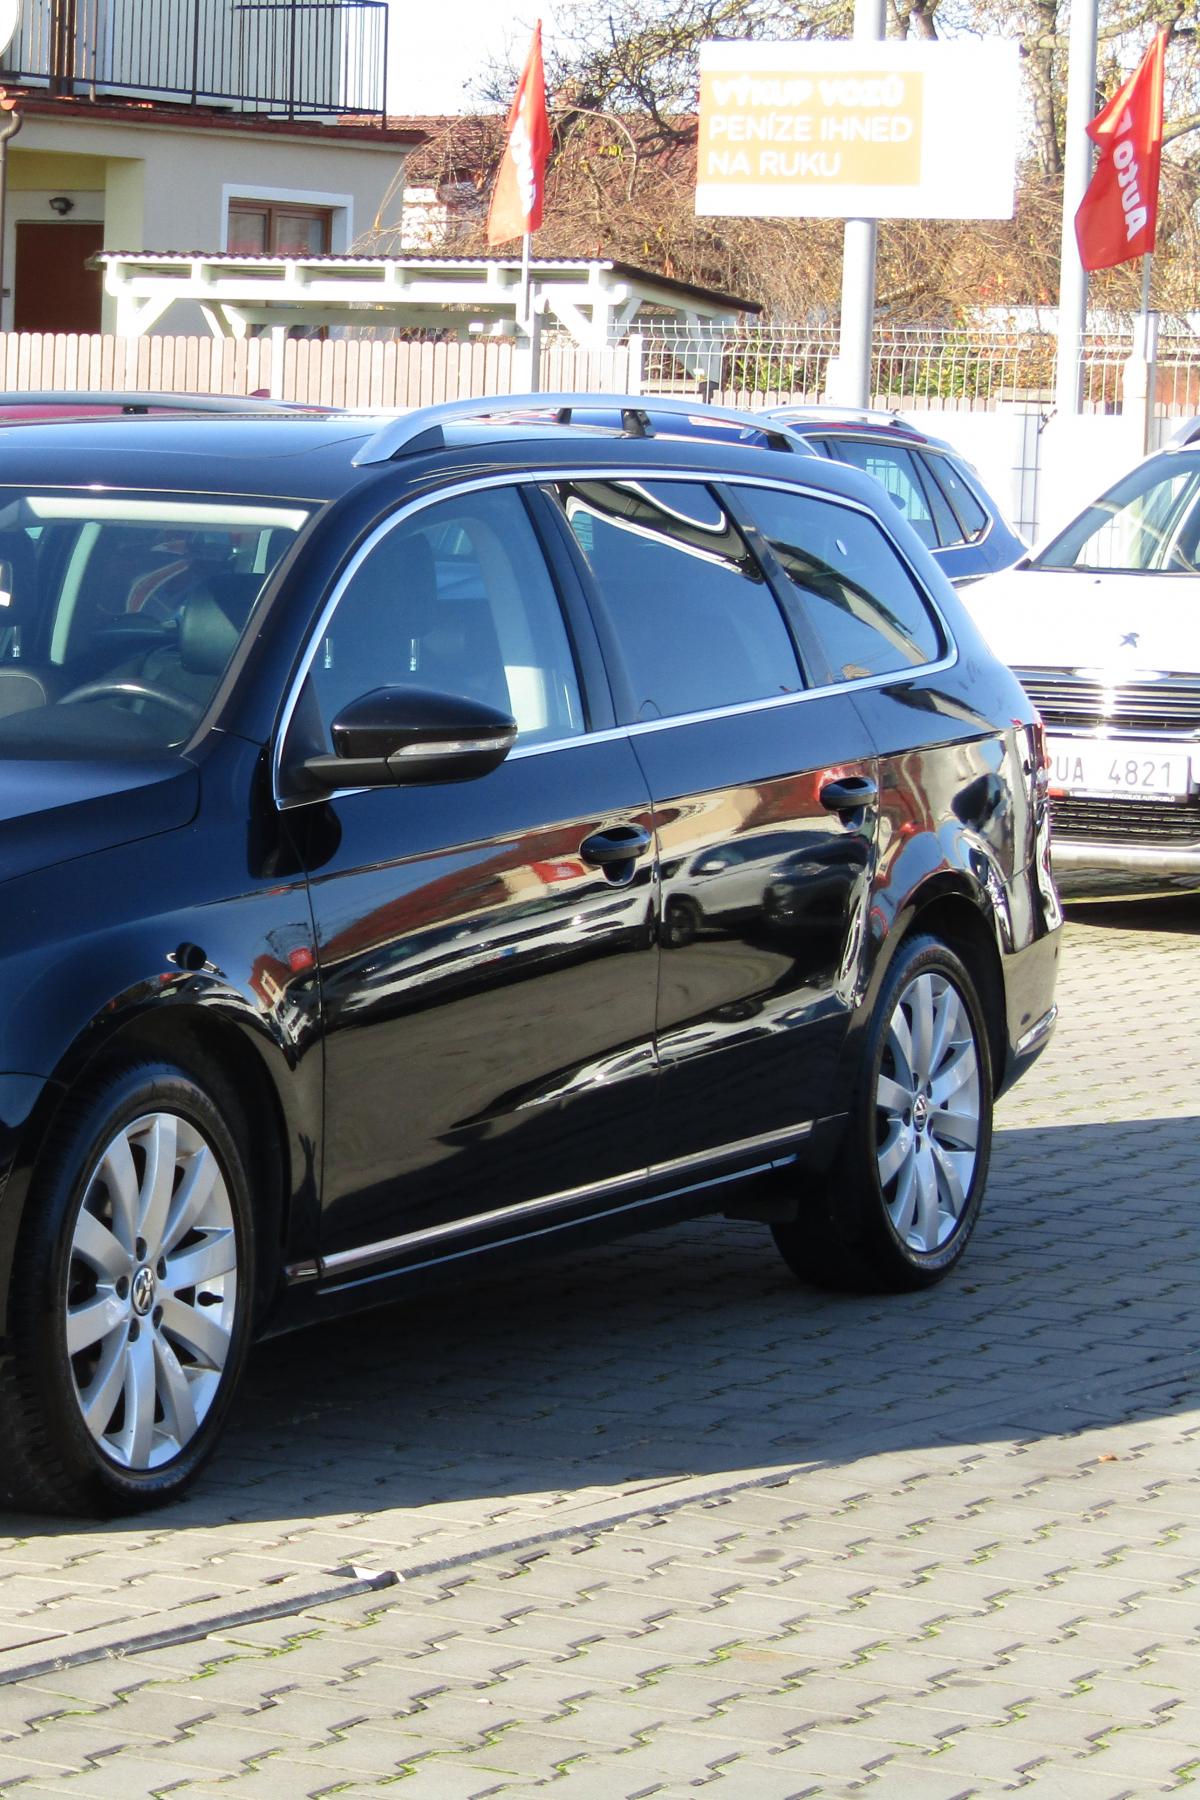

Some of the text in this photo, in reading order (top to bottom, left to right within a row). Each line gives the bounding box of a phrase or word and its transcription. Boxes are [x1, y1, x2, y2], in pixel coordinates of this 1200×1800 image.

[708, 112, 913, 143] PENÍZE IHNED
[707, 150, 843, 177] NA RUKU
[1108, 759, 1172, 788] 4821
